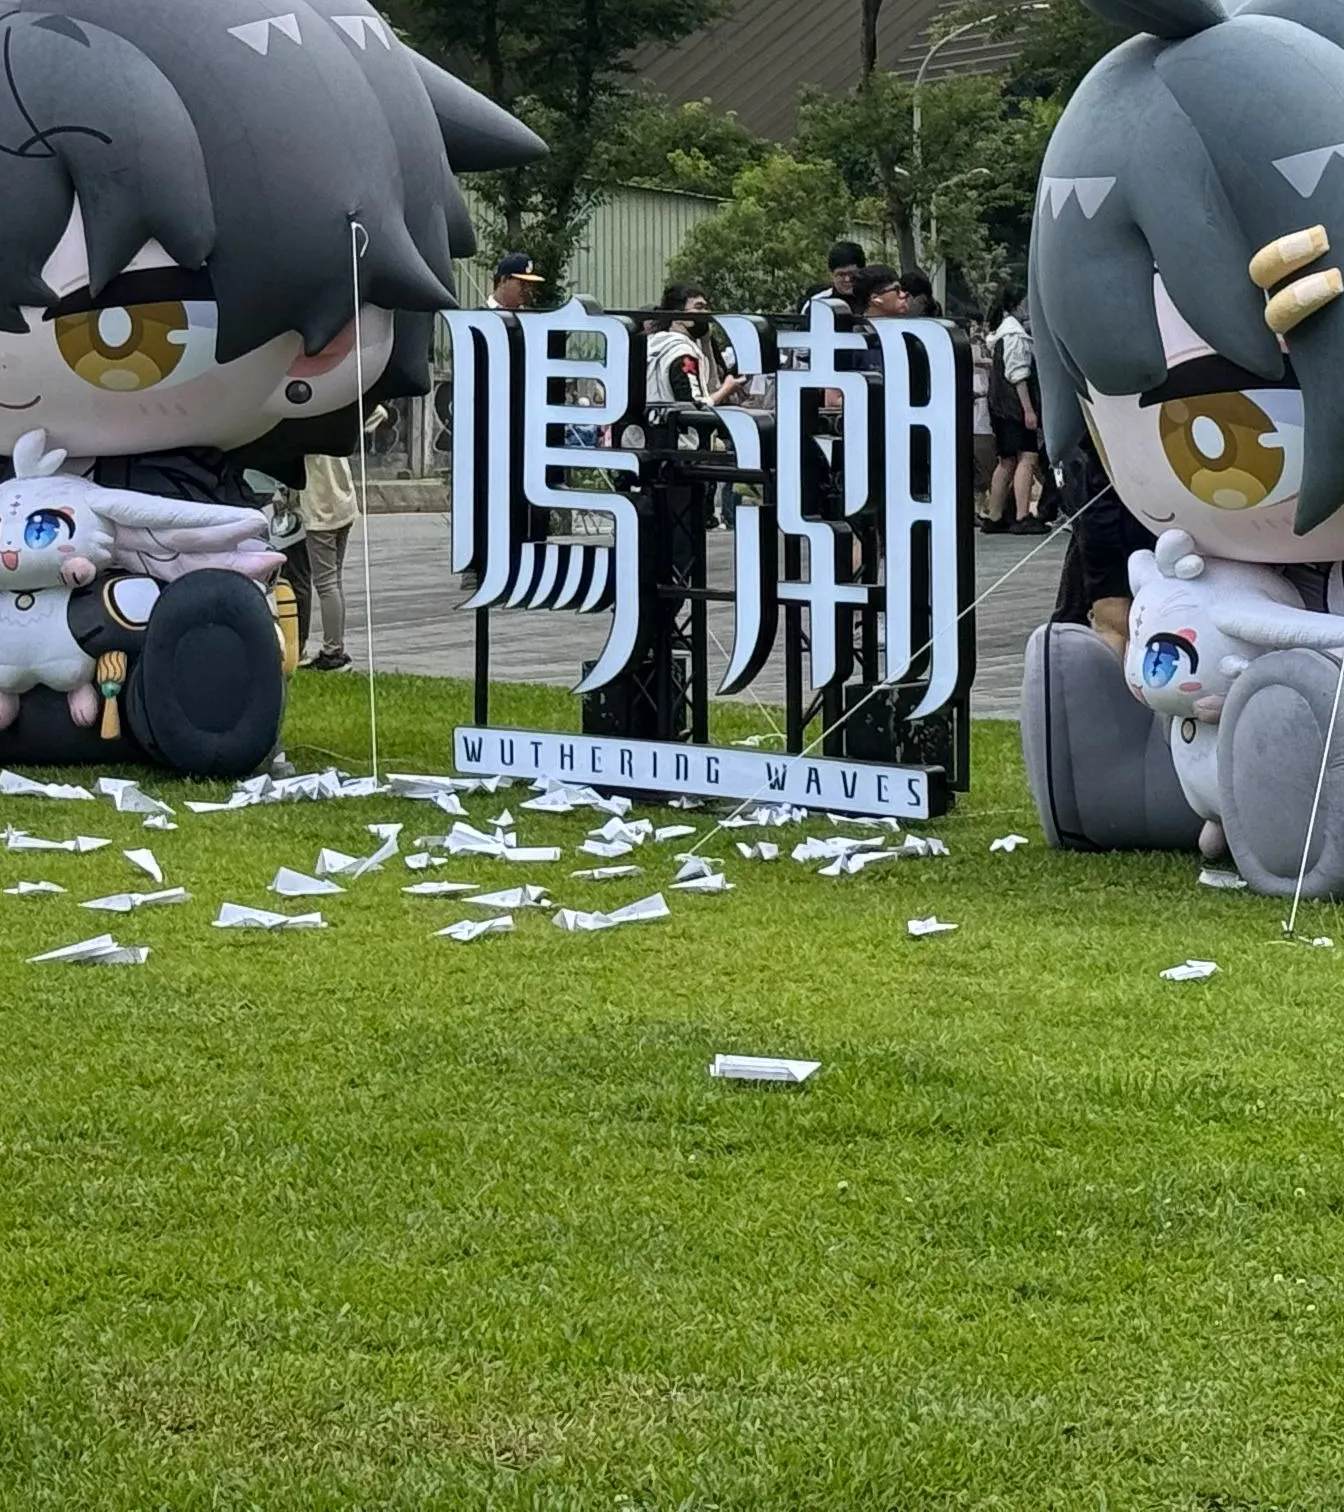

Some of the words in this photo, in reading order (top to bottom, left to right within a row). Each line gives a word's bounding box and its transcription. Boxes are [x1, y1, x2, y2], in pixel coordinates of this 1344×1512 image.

[442, 294, 960, 721] 鳴潮
[462, 735, 721, 785] WUTHERING
[765, 761, 922, 807] WAVES
